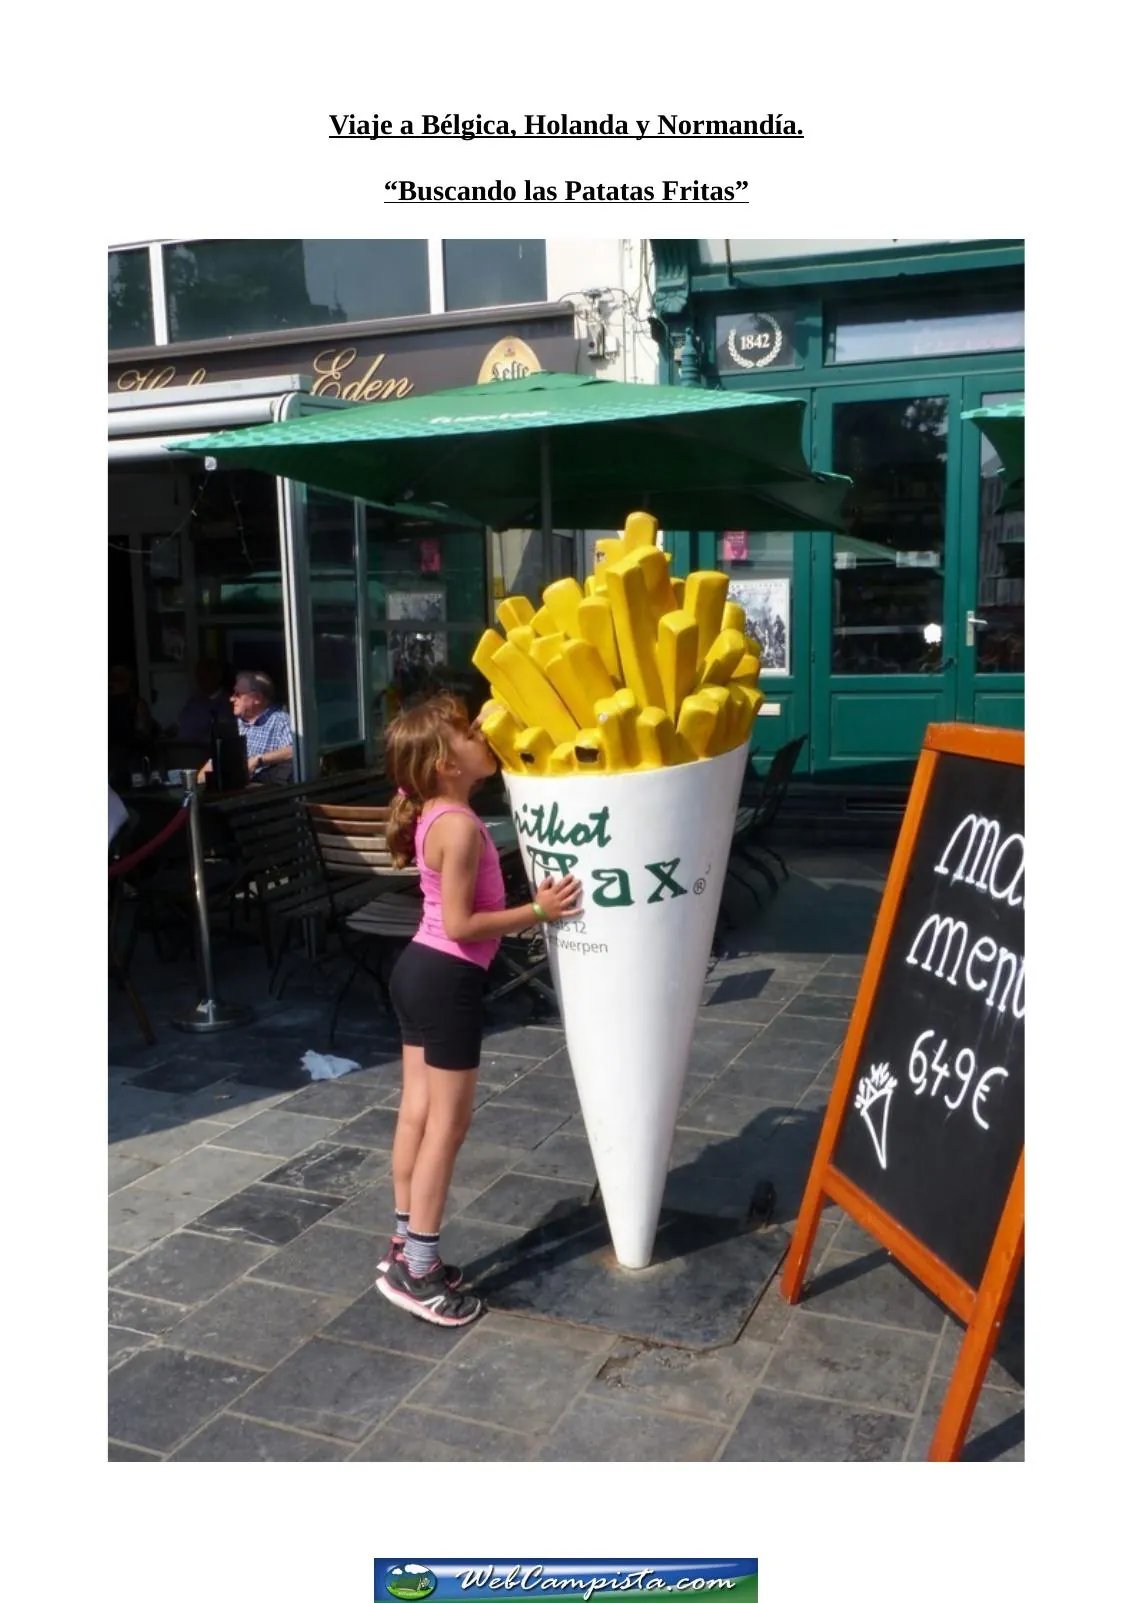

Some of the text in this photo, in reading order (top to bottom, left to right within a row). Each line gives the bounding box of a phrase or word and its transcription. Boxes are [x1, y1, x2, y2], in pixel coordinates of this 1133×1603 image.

[740, 333, 770, 351] 1842
[311, 347, 414, 400] Eden
[575, 920, 587, 935] 12
